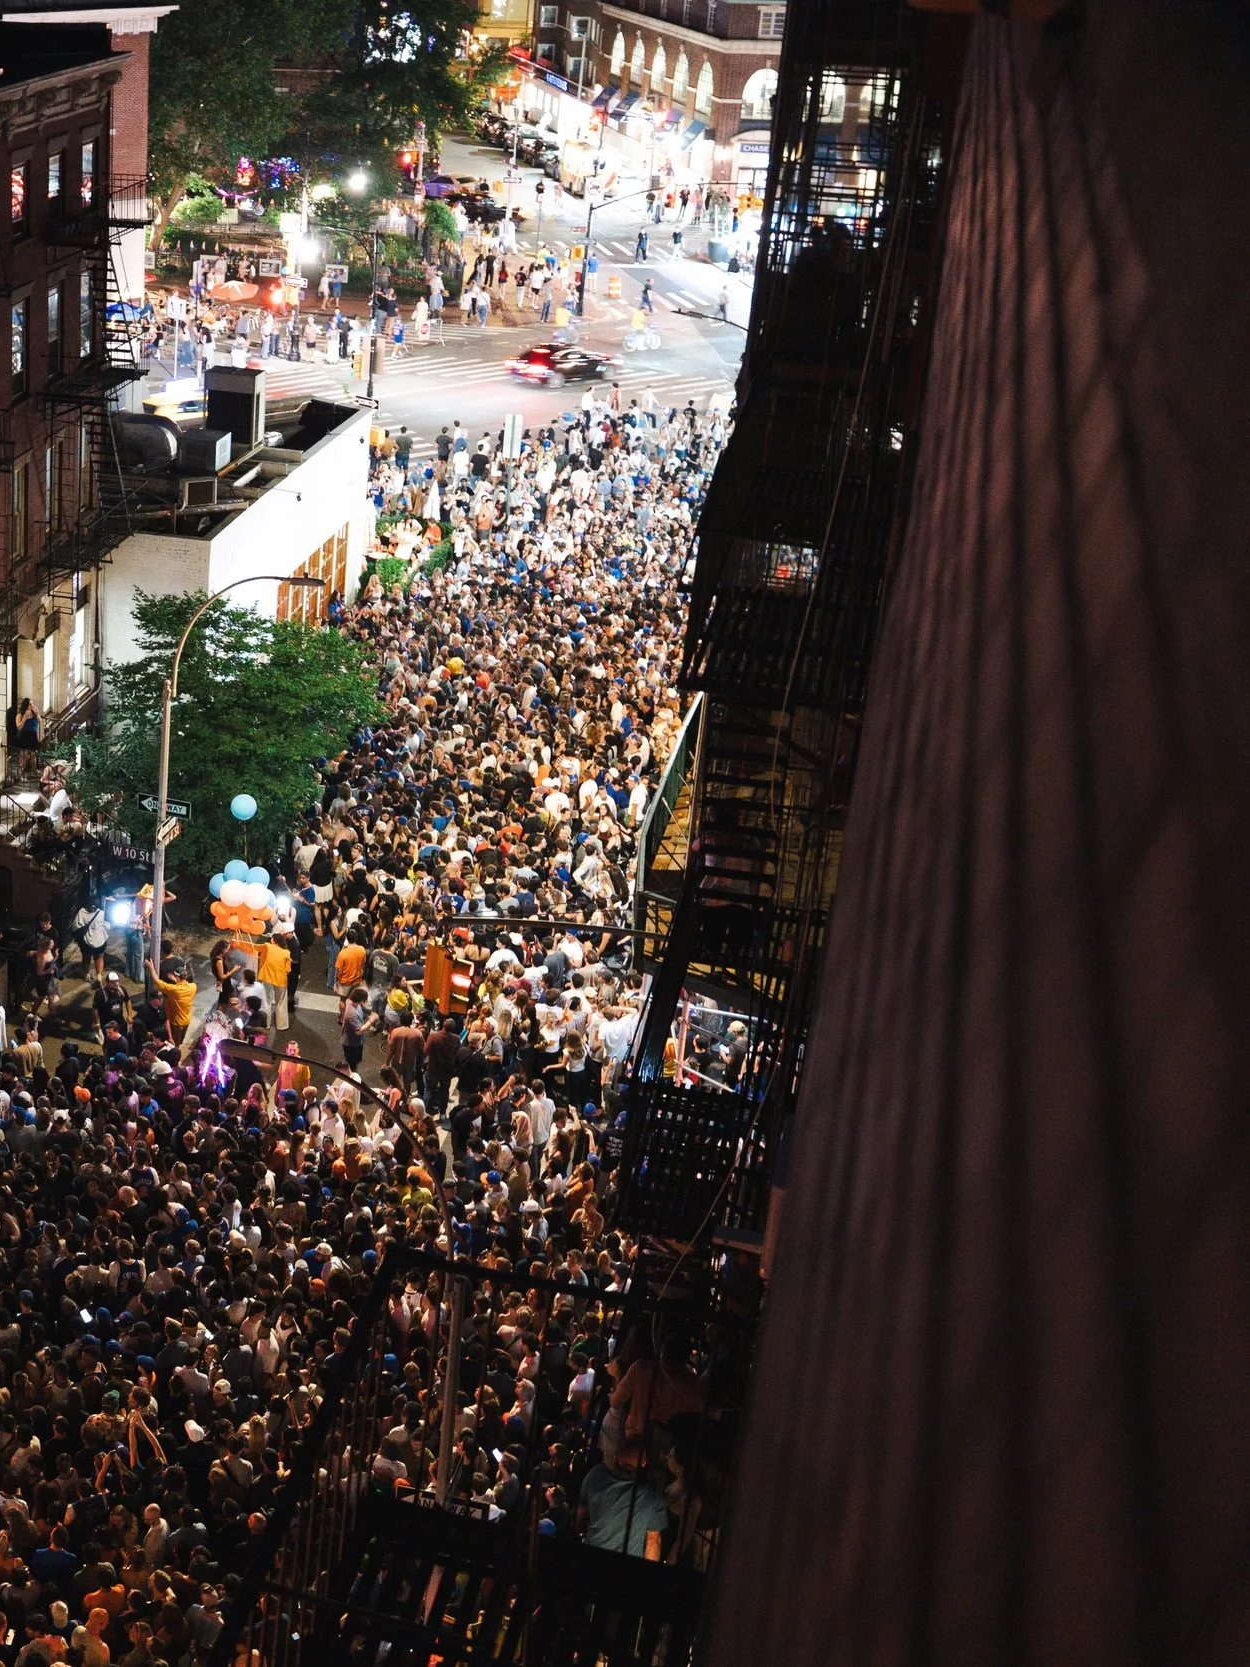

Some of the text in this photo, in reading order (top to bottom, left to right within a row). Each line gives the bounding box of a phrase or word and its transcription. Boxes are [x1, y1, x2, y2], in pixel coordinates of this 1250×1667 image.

[167, 804, 183, 812] WAY
[113, 846, 150, 861] W 10 St
